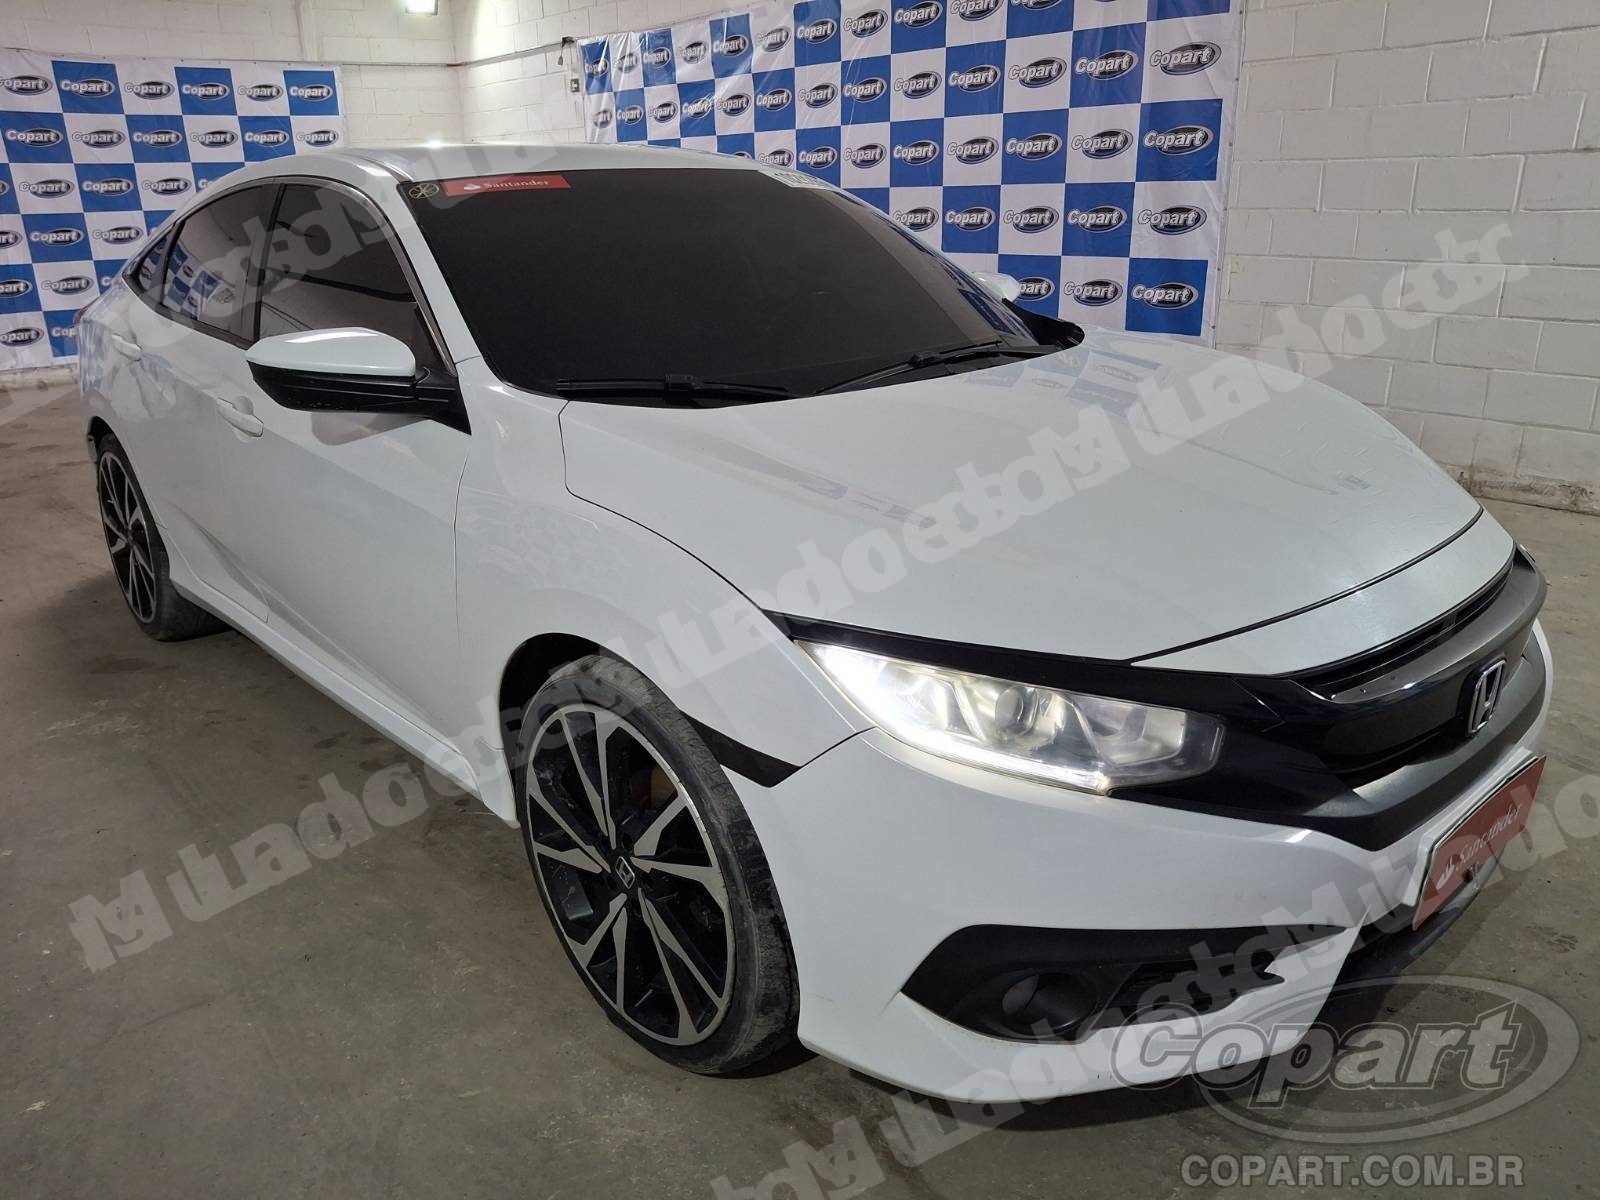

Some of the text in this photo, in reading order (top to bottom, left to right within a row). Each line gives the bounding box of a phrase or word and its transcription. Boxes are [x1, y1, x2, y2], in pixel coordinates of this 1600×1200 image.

[894, 7, 937, 25] Copart
[797, 22, 832, 39] Copart
[844, 15, 881, 33] Copart
[713, 38, 745, 54] Copart
[1150, 47, 1211, 67] Copart
[1009, 63, 1059, 82] Copart
[1075, 55, 1129, 75] Copart
[894, 76, 934, 92] Copart
[948, 70, 994, 87] Copart
[60, 80, 110, 95] Copart
[124, 82, 168, 95] Copart
[182, 84, 224, 97] Copart
[238, 86, 277, 97] Copart
[289, 86, 328, 98] Copart
[799, 86, 834, 102] Copart
[844, 81, 881, 97] Copart
[716, 96, 747, 111] Copart
[756, 91, 787, 106] Copart
[617, 109, 640, 122] Copart
[649, 104, 675, 119] Copart
[6, 129, 57, 143] Copart
[72, 131, 119, 143] Copart
[133, 132, 177, 144] Copart
[191, 132, 232, 144] Copart
[245, 132, 284, 144] Copart
[296, 131, 334, 142] Copart
[1072, 133, 1125, 153] Copart
[1144, 129, 1204, 149] Copart
[893, 144, 934, 161] Copart
[947, 141, 991, 159] Copart
[1006, 137, 1055, 156] Copart
[799, 150, 833, 164] Copart
[843, 147, 880, 163] Copart
[19, 181, 68, 194] Copart
[82, 180, 128, 193] Copart
[142, 180, 185, 192] Copart
[483, 179, 549, 189] Santander
[893, 210, 932, 224] Copart
[945, 210, 989, 226] Copart
[1004, 210, 1051, 226] Copart
[1068, 209, 1120, 227] Copart
[1138, 209, 1198, 227] Copart
[30, 230, 78, 243] Copart
[92, 229, 137, 241] Copart
[0, 280, 25, 292] art
[41, 279, 87, 292] Copart
[1018, 283, 1048, 296] part
[1064, 281, 1116, 299] Copart
[1132, 284, 1191, 302] Copart
[0, 330, 37, 343] opart
[52, 327, 77, 338] Cop
